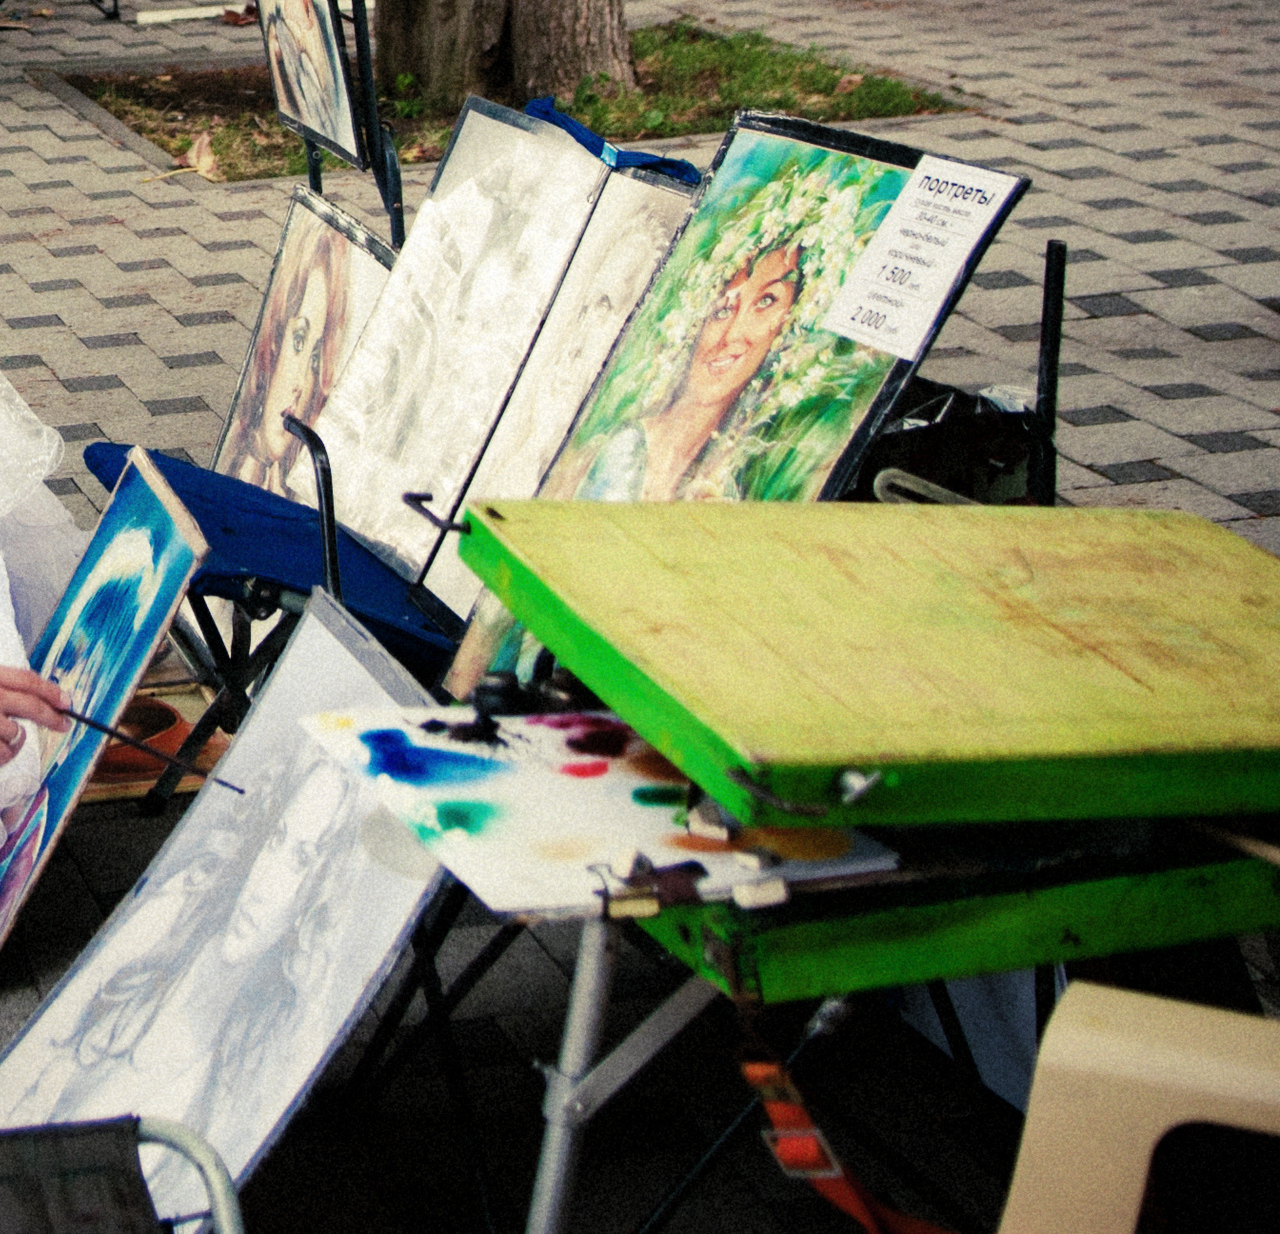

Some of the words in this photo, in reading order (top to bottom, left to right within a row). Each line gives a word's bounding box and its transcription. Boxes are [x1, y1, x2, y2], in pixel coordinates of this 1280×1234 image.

[918, 175, 996, 206] портреты
[885, 266, 912, 286] 500
[860, 309, 887, 330] 000
